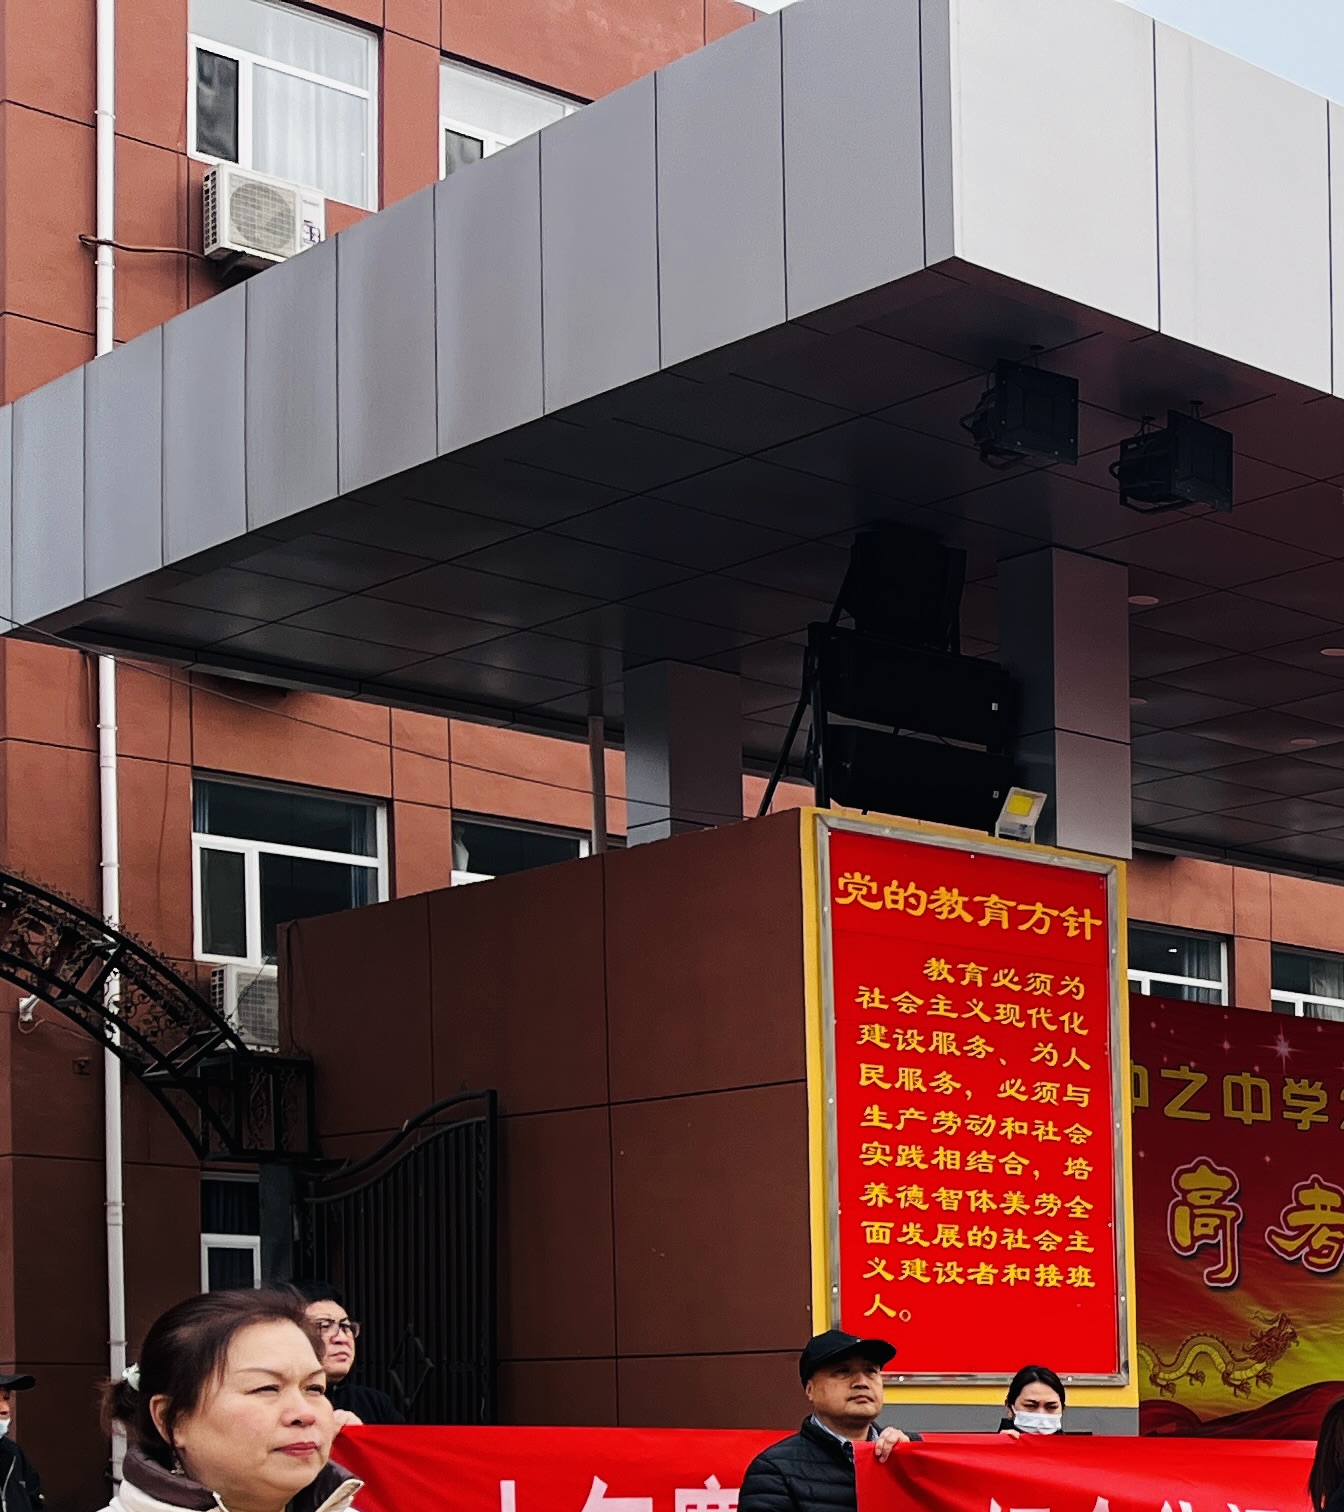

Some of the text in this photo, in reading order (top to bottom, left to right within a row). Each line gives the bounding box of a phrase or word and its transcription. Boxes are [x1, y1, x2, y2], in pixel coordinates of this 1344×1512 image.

[834, 871, 1103, 941] 党的教育方针
[923, 956, 1085, 1000] 教育必须为
[854, 985, 1089, 1036] 社会主义现代化
[860, 1104, 1093, 1145] 生产劳动和社会
[860, 1182, 1094, 1220] 养德智体美劳全
[861, 1220, 1095, 1254] 面发展的社会主
[862, 1256, 1096, 1289] 义建设者和接班
